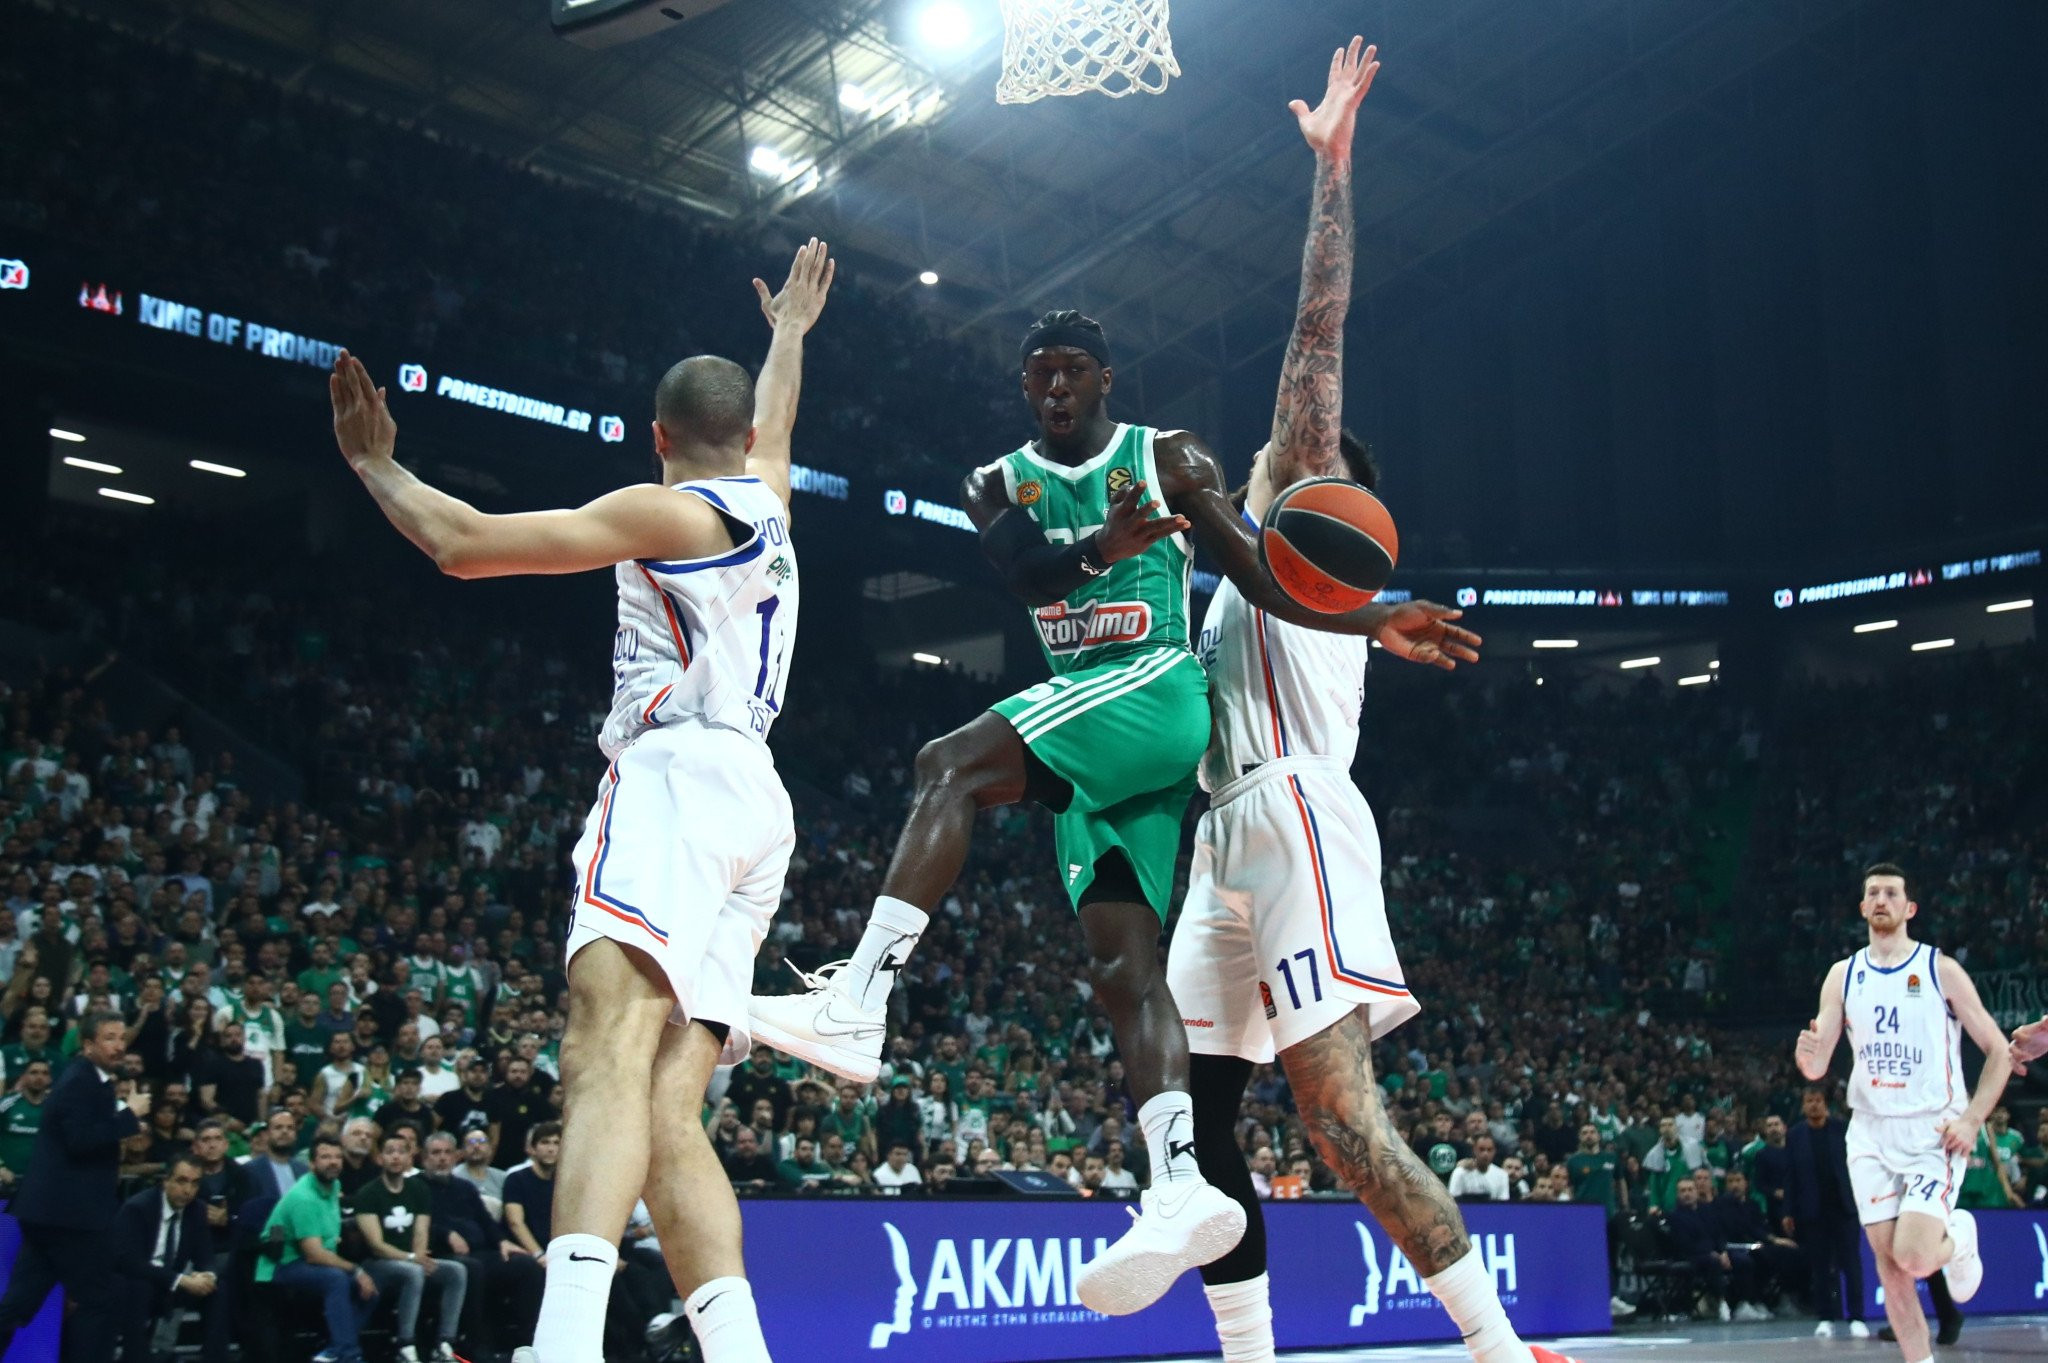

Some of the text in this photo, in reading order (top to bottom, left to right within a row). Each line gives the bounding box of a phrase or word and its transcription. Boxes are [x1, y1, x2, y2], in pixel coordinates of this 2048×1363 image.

[139, 293, 342, 370] KING OF PROMO
[790, 463, 849, 500] ROMOS
[1276, 948, 1323, 1010] 17
[1181, 1017, 1214, 1029] rendon
[1874, 1005, 1900, 1034] 24
[1860, 1042, 1923, 1064] ANADOLU
[1867, 1060, 1912, 1076] EFES
[1908, 1174, 1939, 1202] 24
[1385, 1233, 1518, 1295] ΑΗ
